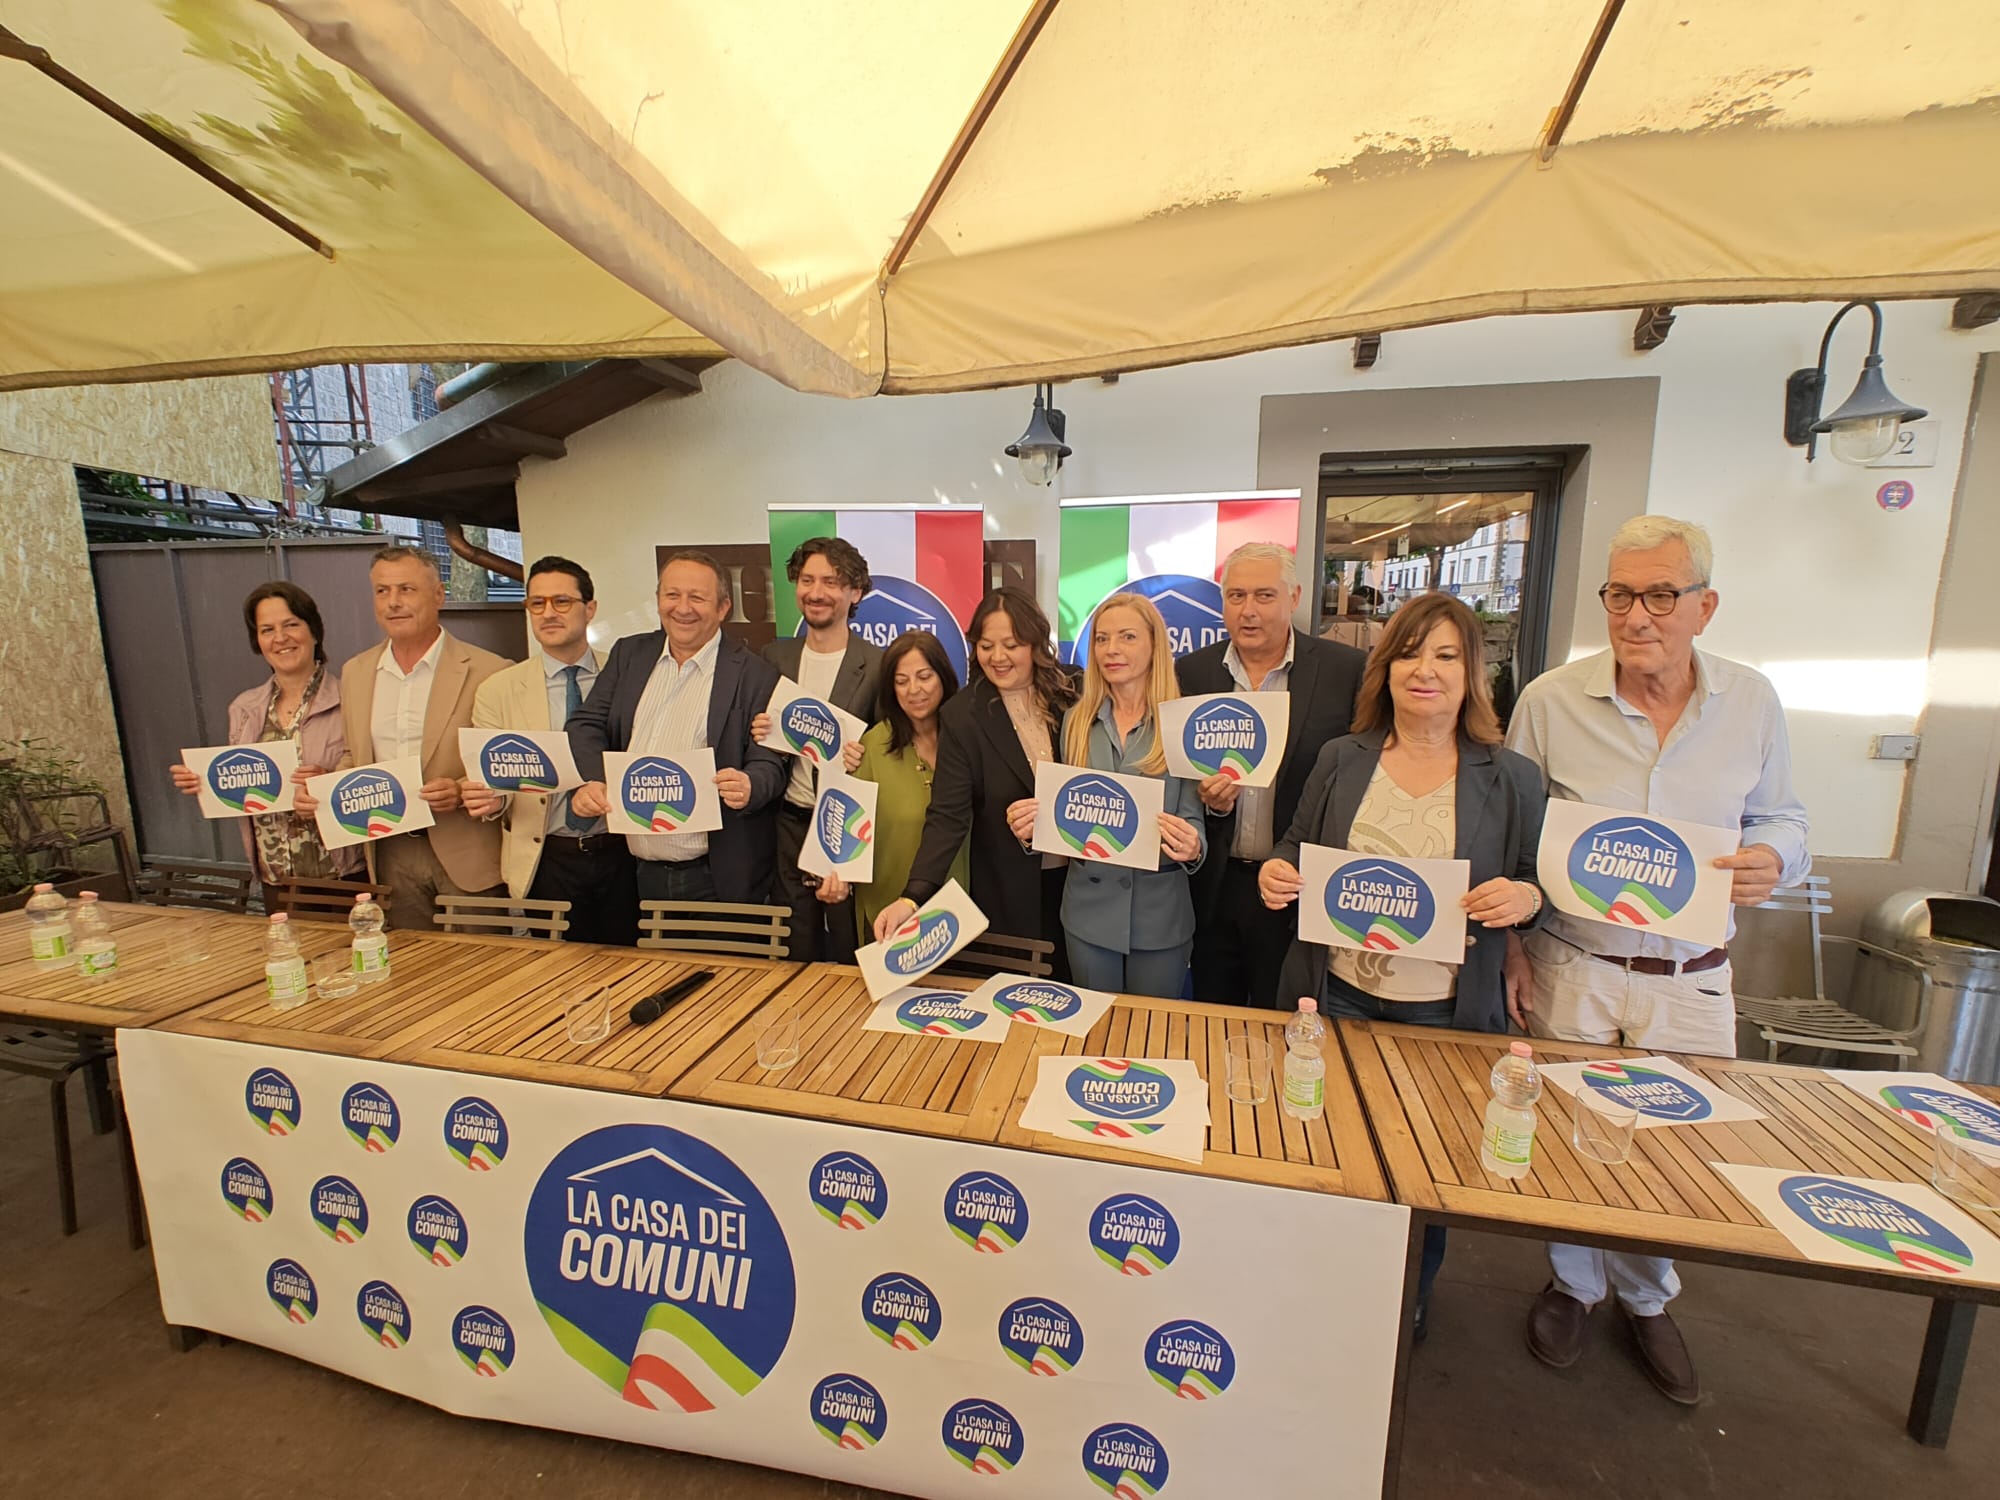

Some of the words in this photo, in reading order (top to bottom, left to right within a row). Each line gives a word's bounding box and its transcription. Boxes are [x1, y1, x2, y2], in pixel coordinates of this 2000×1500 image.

[1201, 627, 1228, 648] DE
[792, 708, 801, 719] LA
[802, 713, 822, 728] CASA
[823, 722, 835, 733] DEI
[1195, 721, 1208, 732] LA
[1210, 720, 1236, 732] CASA
[1238, 719, 1254, 731] DEI
[788, 717, 835, 746] COMUNI
[1194, 732, 1256, 750] COMUNI
[489, 752, 501, 762] LA
[501, 753, 525, 763] CASA
[525, 754, 540, 764] DEI
[217, 766, 229, 776] LA
[230, 764, 252, 775] CASA
[254, 761, 267, 772] DEI
[490, 763, 545, 777] COMUNI
[218, 771, 270, 790] COMUNI
[630, 776, 641, 786] LA
[641, 776, 665, 787] CASA
[665, 775, 680, 785] DEI
[340, 790, 352, 801] LA
[352, 785, 375, 798] CASA
[377, 781, 391, 792] DEI
[630, 786, 683, 803] COMUNI
[1068, 791, 1080, 803] LA
[1082, 793, 1106, 808] CASA
[1110, 797, 1125, 810] DEI
[341, 790, 394, 815] COMUNI
[1064, 803, 1127, 828] COMUNI
[830, 800, 846, 855] COMUNI
[1592, 837, 1609, 853] LA
[1613, 841, 1649, 861] CASA
[1653, 848, 1678, 866] DEI
[1583, 852, 1679, 888] COMUNI
[1342, 878, 1357, 892] LA
[1360, 880, 1392, 896] CASA
[1396, 885, 1417, 899] DEI
[1338, 891, 1419, 918] COMUNI
[898, 919, 948, 967] COMUNI
[1006, 992, 1068, 1011] COMUNI
[1029, 990, 1054, 998] CASA
[908, 1006, 976, 1020] COMUNI
[932, 1001, 957, 1009] CASA
[253, 1083, 261, 1093] LA
[262, 1085, 279, 1095] CASA
[280, 1087, 291, 1097] DEI
[1082, 1080, 1160, 1094] COMUNI
[1607, 1082, 1683, 1097] COMUNI
[252, 1092, 293, 1111] COMUNI
[350, 1097, 359, 1107] LA
[360, 1099, 378, 1111] CASA
[379, 1101, 390, 1112] DEI
[1084, 1092, 1104, 1102] DEI
[1107, 1094, 1140, 1103] CASA
[1142, 1094, 1159, 1103] LA
[1643, 1096, 1681, 1105] CASA
[1673, 1094, 1697, 1103] LA
[349, 1108, 392, 1127] COMUNI
[454, 1113, 464, 1123] LA
[465, 1115, 484, 1127] CASA
[485, 1117, 498, 1129] DEI
[452, 1123, 500, 1144] COMUNI
[228, 1172, 236, 1181] LA
[237, 1173, 253, 1184] CASA
[254, 1176, 264, 1187] DEI
[822, 1168, 833, 1180] LA
[835, 1170, 858, 1184] CASA
[860, 1174, 874, 1186] DEI
[228, 1180, 266, 1200] COMUNI
[319, 1190, 328, 1200] LA
[328, 1191, 346, 1203] CASA
[347, 1194, 358, 1205] DEI
[820, 1180, 876, 1202] COMUNI
[958, 1188, 970, 1201] LA
[972, 1190, 997, 1205] CASA
[1000, 1195, 1015, 1208] DEI
[318, 1200, 360, 1220] COMUNI
[955, 1201, 1016, 1225] COMUNI
[1795, 1192, 1826, 1207] LA
[1821, 1195, 1876, 1212] CASA
[1868, 1201, 1906, 1216] DEI
[417, 1210, 426, 1220] LA
[427, 1212, 445, 1224] CASA
[446, 1215, 458, 1227] DEI
[567, 1186, 603, 1227] LA
[611, 1194, 690, 1241] CASA
[699, 1207, 746, 1251] DEI
[1104, 1211, 1117, 1223] LA
[1120, 1213, 1146, 1227] CASA
[1149, 1217, 1165, 1230] DEI
[1810, 1206, 1930, 1236] COMUNI
[415, 1220, 460, 1242] COMUNI
[1101, 1223, 1166, 1247] COMUNI
[560, 1228, 752, 1310] COMUNI
[274, 1272, 282, 1281] LA
[282, 1273, 298, 1284] CASA
[299, 1278, 309, 1288] DEI
[273, 1280, 311, 1302] COMUNI
[875, 1288, 886, 1300] LA
[888, 1290, 911, 1305] CASA
[914, 1295, 928, 1307] DEI
[365, 1294, 373, 1304] LA
[373, 1296, 391, 1308] CASA
[392, 1300, 402, 1312] DEI
[872, 1300, 930, 1323] COMUNI
[364, 1303, 404, 1326] COMUNI
[1013, 1312, 1024, 1324] LA
[1027, 1315, 1052, 1329] CASA
[1054, 1320, 1069, 1332] DEI
[461, 1320, 471, 1329] LA
[472, 1321, 491, 1335] CASA
[493, 1326, 505, 1336] DEI
[1010, 1324, 1071, 1348] COMUNI
[460, 1329, 506, 1352] COMUNI
[1161, 1336, 1172, 1348] LA
[1175, 1338, 1201, 1353] CASA
[1204, 1343, 1220, 1356] DEI
[1156, 1348, 1222, 1372] COMUNI
[823, 1389, 834, 1400] LA
[836, 1391, 858, 1406] CASA
[860, 1396, 875, 1408] DEI
[821, 1400, 876, 1424] COMUNI
[956, 1413, 967, 1425] LA
[969, 1416, 993, 1430] CASA
[996, 1420, 1010, 1433] DEI
[953, 1425, 1012, 1448] COMUNI
[1097, 1438, 1109, 1450] LA
[1112, 1440, 1136, 1454] CASA
[1139, 1445, 1155, 1457] DEI
[1094, 1450, 1156, 1473] COMUNI
